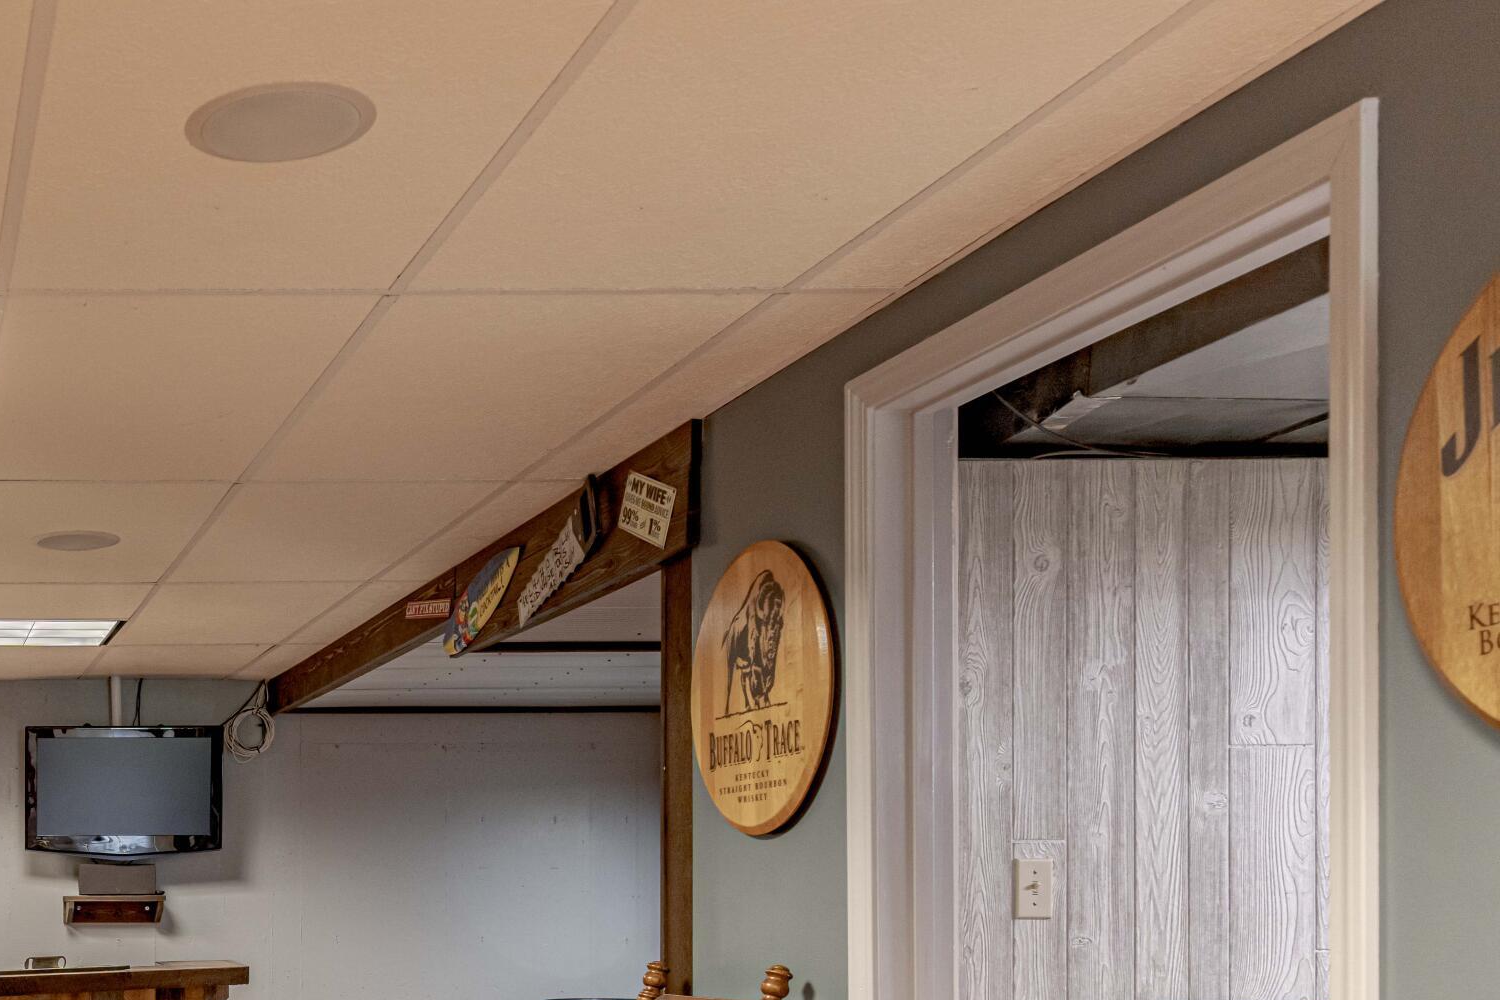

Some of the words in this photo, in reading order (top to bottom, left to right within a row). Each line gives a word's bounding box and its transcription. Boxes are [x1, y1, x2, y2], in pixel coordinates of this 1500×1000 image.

[631, 477, 646, 496] MY
[646, 483, 667, 506] WIFE
[708, 731, 752, 773] BUFFALO
[764, 719, 800, 761] TRACE
[735, 769, 769, 782] KENTUCKY
[719, 784, 751, 796] STRAIGHT
[755, 779, 787, 791] BOURBON
[738, 793, 768, 803] WHISKEY
